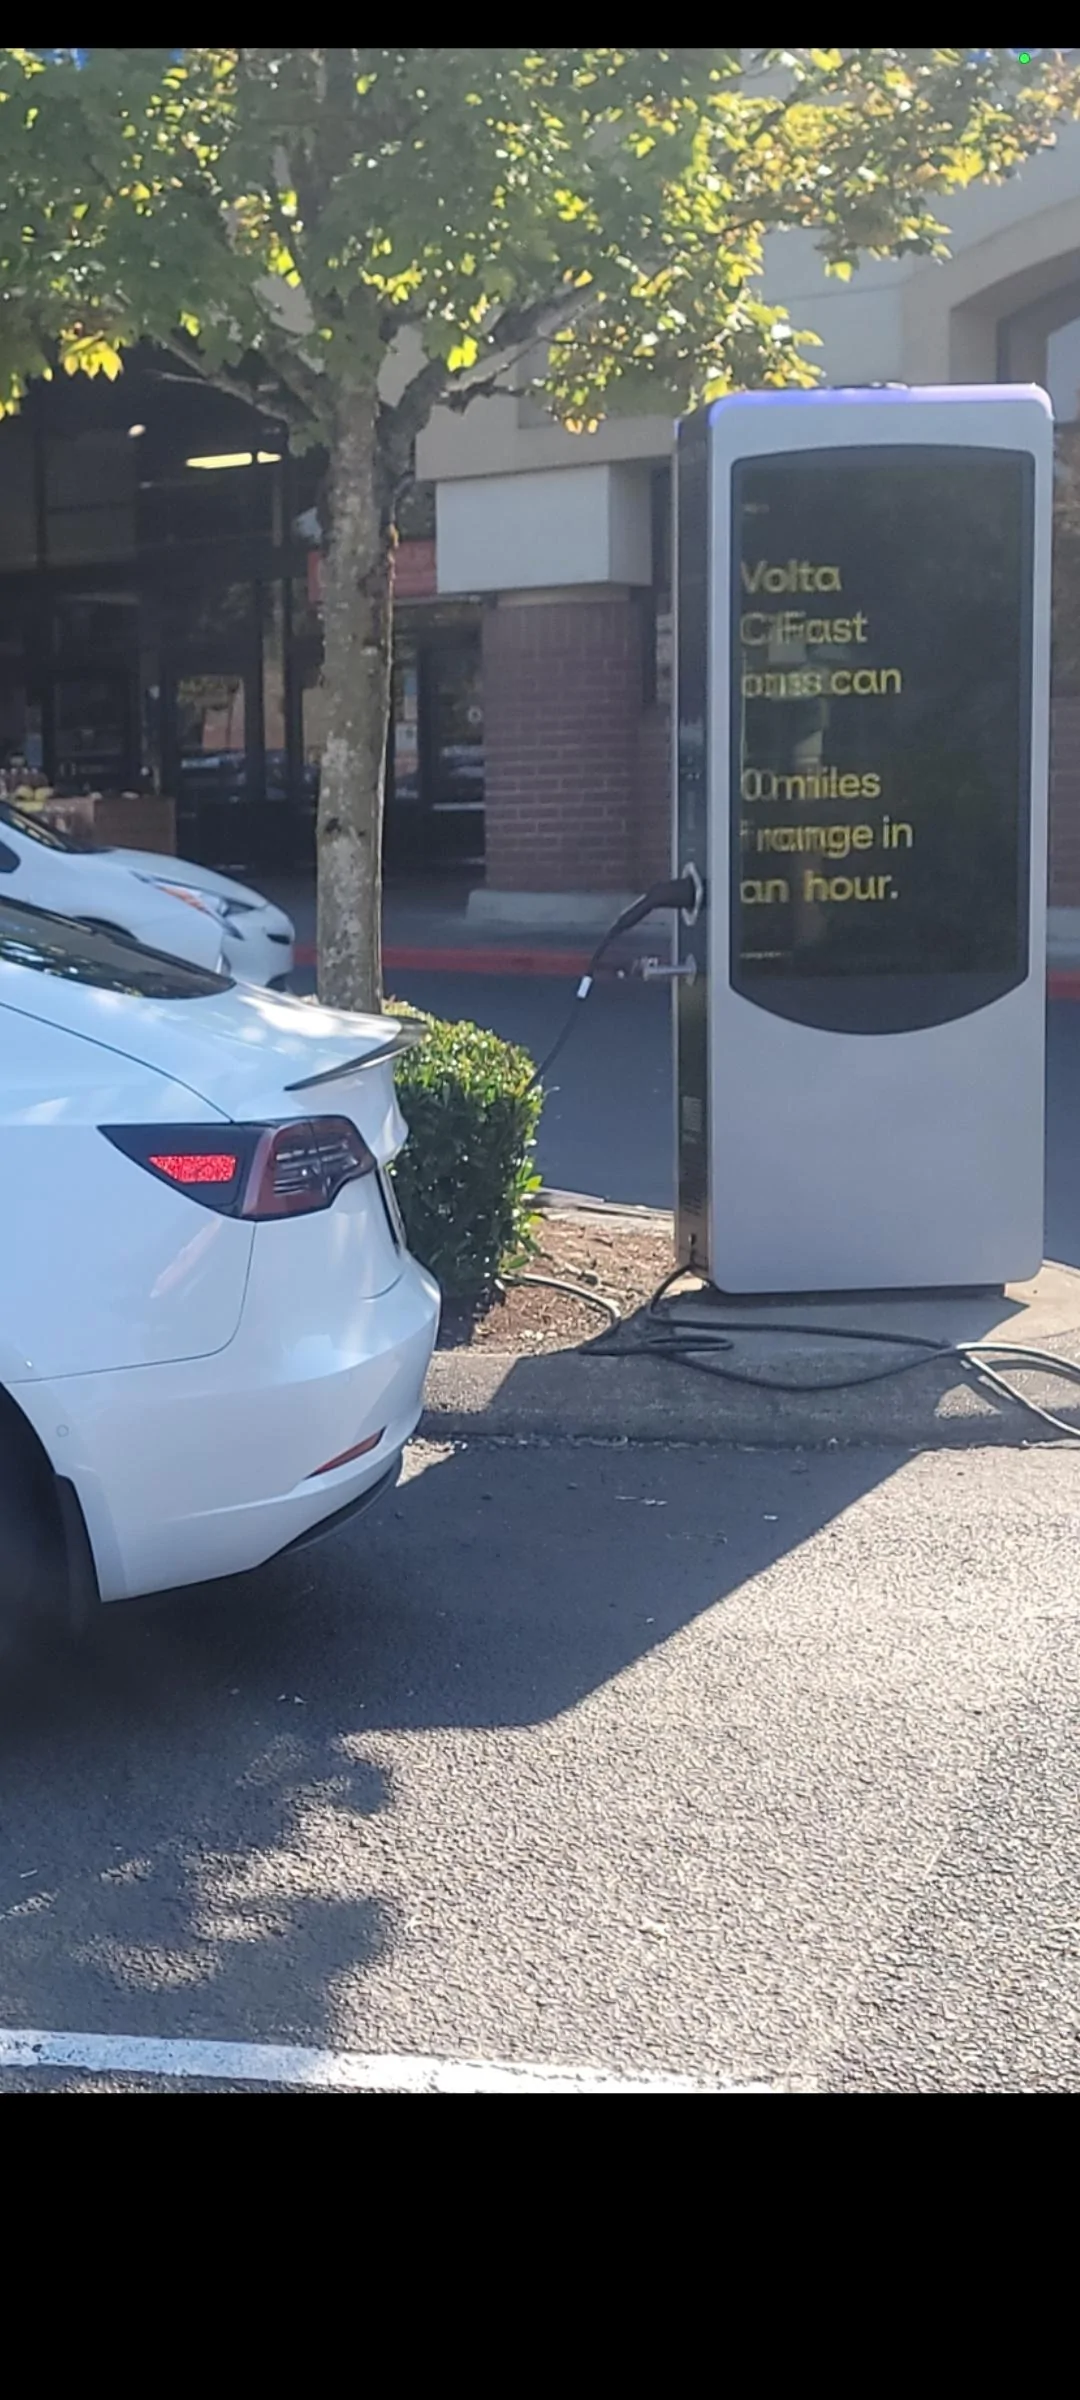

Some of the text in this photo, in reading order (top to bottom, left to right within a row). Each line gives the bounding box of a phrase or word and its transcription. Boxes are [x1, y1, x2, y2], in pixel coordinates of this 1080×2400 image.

[740, 559, 842, 593] Volta
[830, 667, 902, 696] can
[882, 814, 913, 849] in
[739, 869, 899, 904] an hour.
